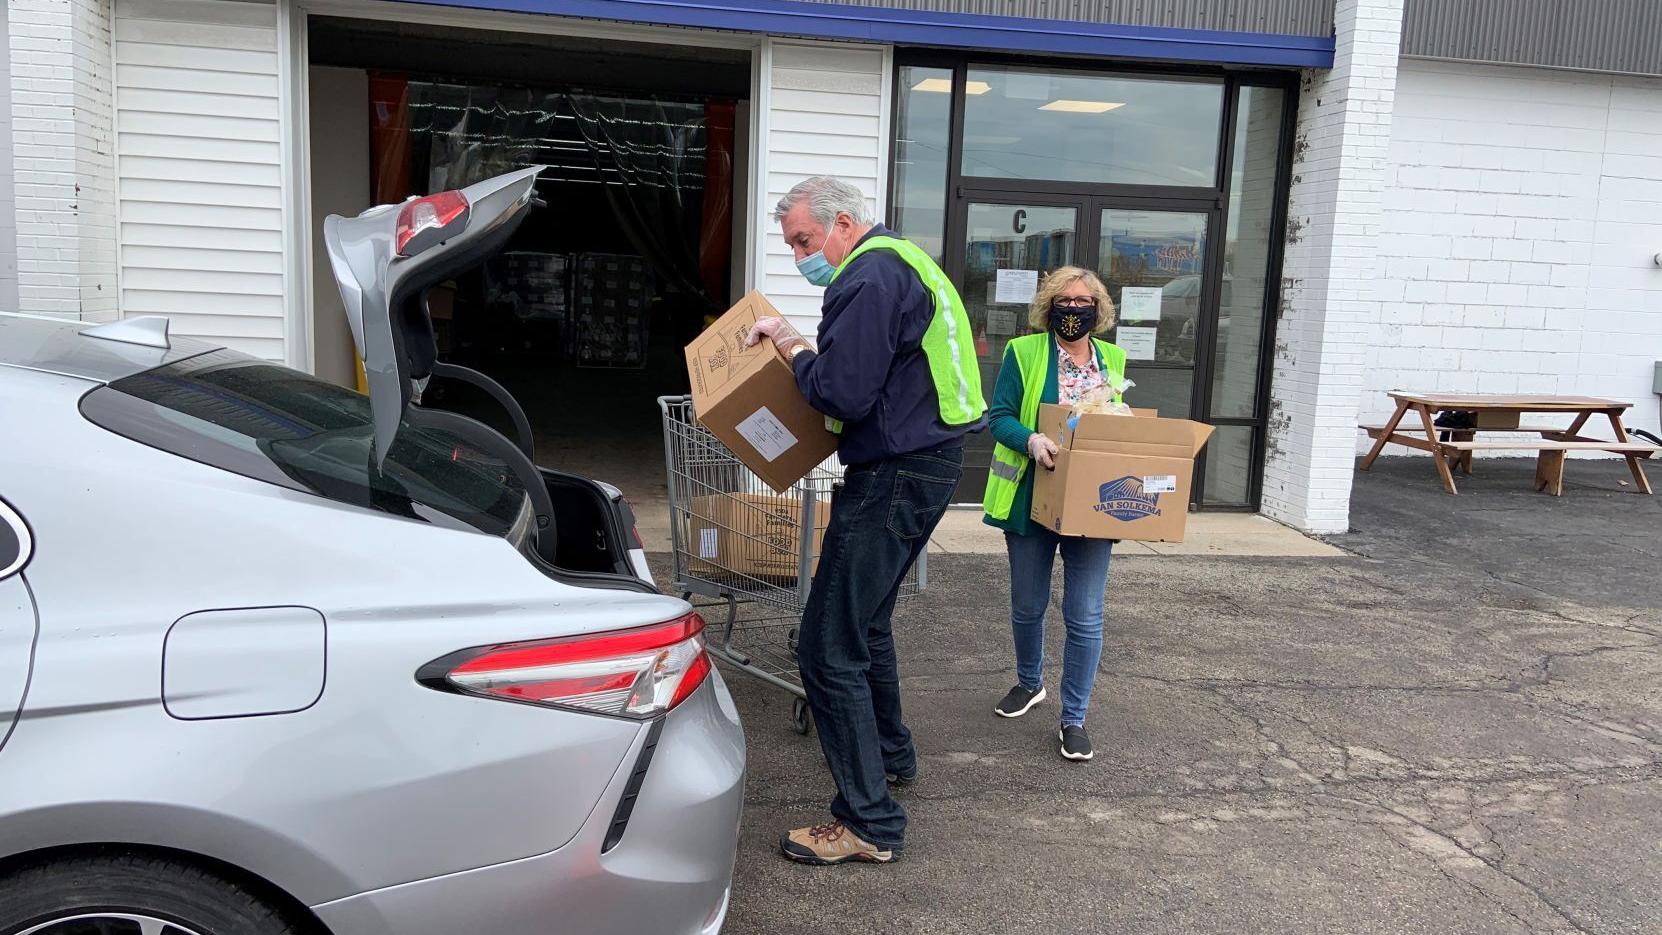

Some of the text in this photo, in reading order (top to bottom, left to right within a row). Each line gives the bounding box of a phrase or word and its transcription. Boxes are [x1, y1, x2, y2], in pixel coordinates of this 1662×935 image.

[1013, 209, 1027, 234] C
[1093, 501, 1162, 517] VAN SOLKEMA
